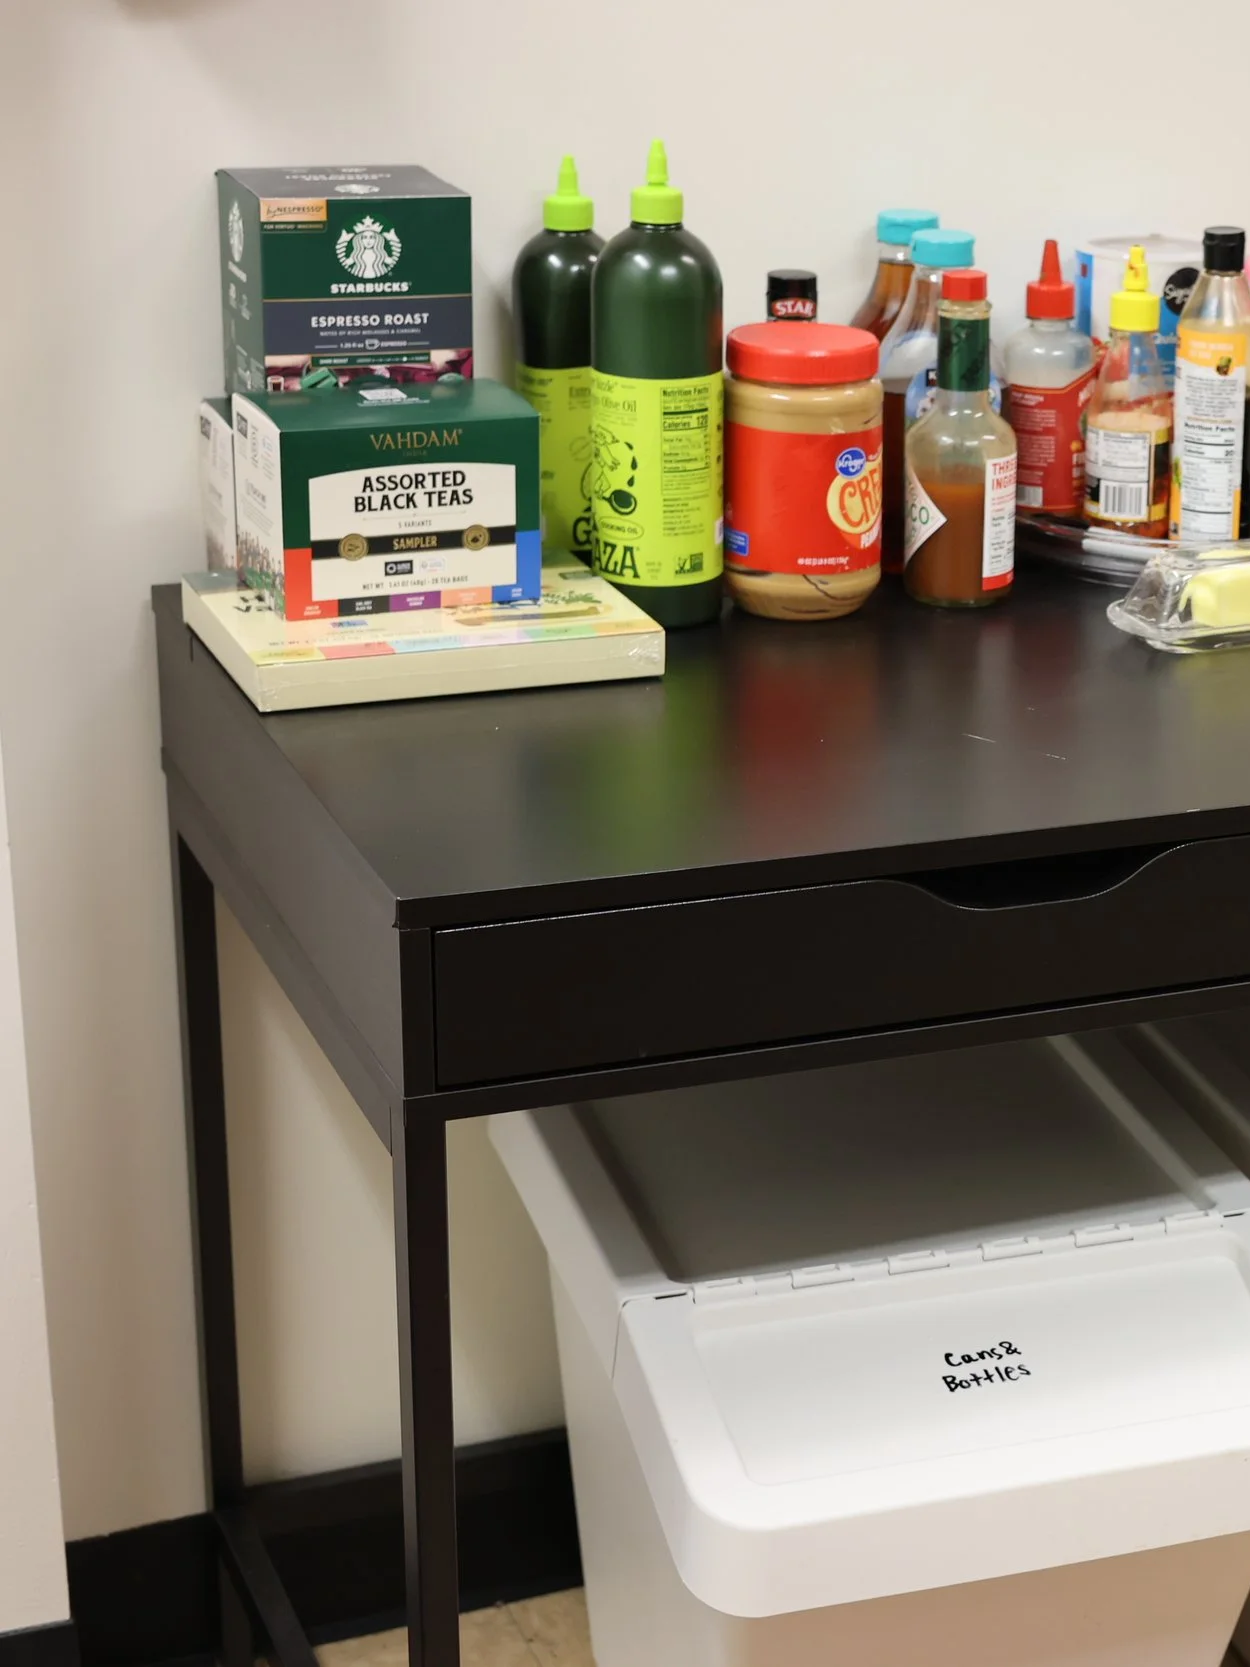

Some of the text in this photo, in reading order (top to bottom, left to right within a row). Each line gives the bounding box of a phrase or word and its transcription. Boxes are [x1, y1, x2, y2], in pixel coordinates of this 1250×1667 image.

[330, 282, 409, 294] STARBUCKS
[776, 300, 814, 318] STAR
[311, 312, 430, 328] ESPRESSO ROAST
[663, 387, 709, 397] Nutrition Facts
[622, 399, 637, 412] Oil
[663, 421, 690, 429] Calories
[1184, 421, 1213, 431] Nutrition
[370, 429, 460, 451] VAHDAM
[838, 453, 866, 473] Kroger
[362, 470, 466, 493] ASSORTED
[354, 489, 474, 513] BLACK TEAS
[838, 467, 881, 528] CRE
[404, 520, 432, 528] VARIANTS
[392, 536, 438, 550] SAMPLER
[942, 1364, 1031, 1392] Bottles
